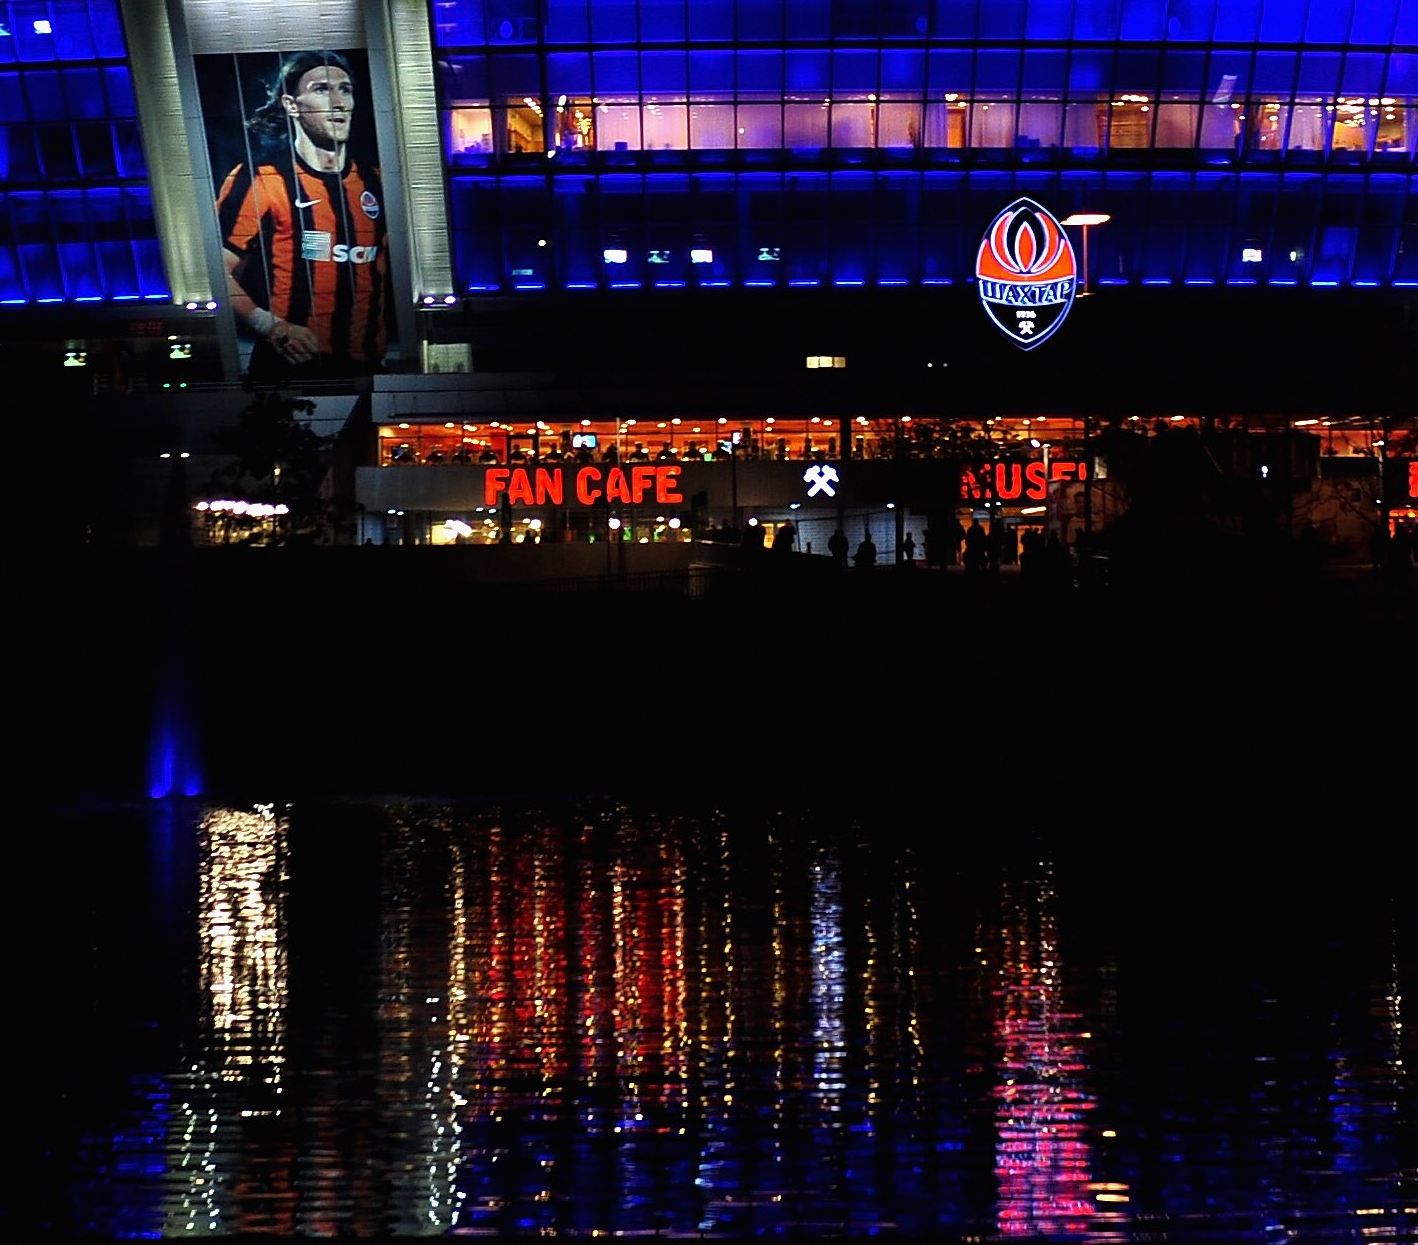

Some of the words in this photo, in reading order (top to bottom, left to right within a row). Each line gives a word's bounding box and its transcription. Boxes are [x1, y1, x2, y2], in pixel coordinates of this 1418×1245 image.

[979, 279, 1072, 304] ШАХТАР
[484, 467, 564, 505] FAN
[576, 466, 683, 505] CAFE
